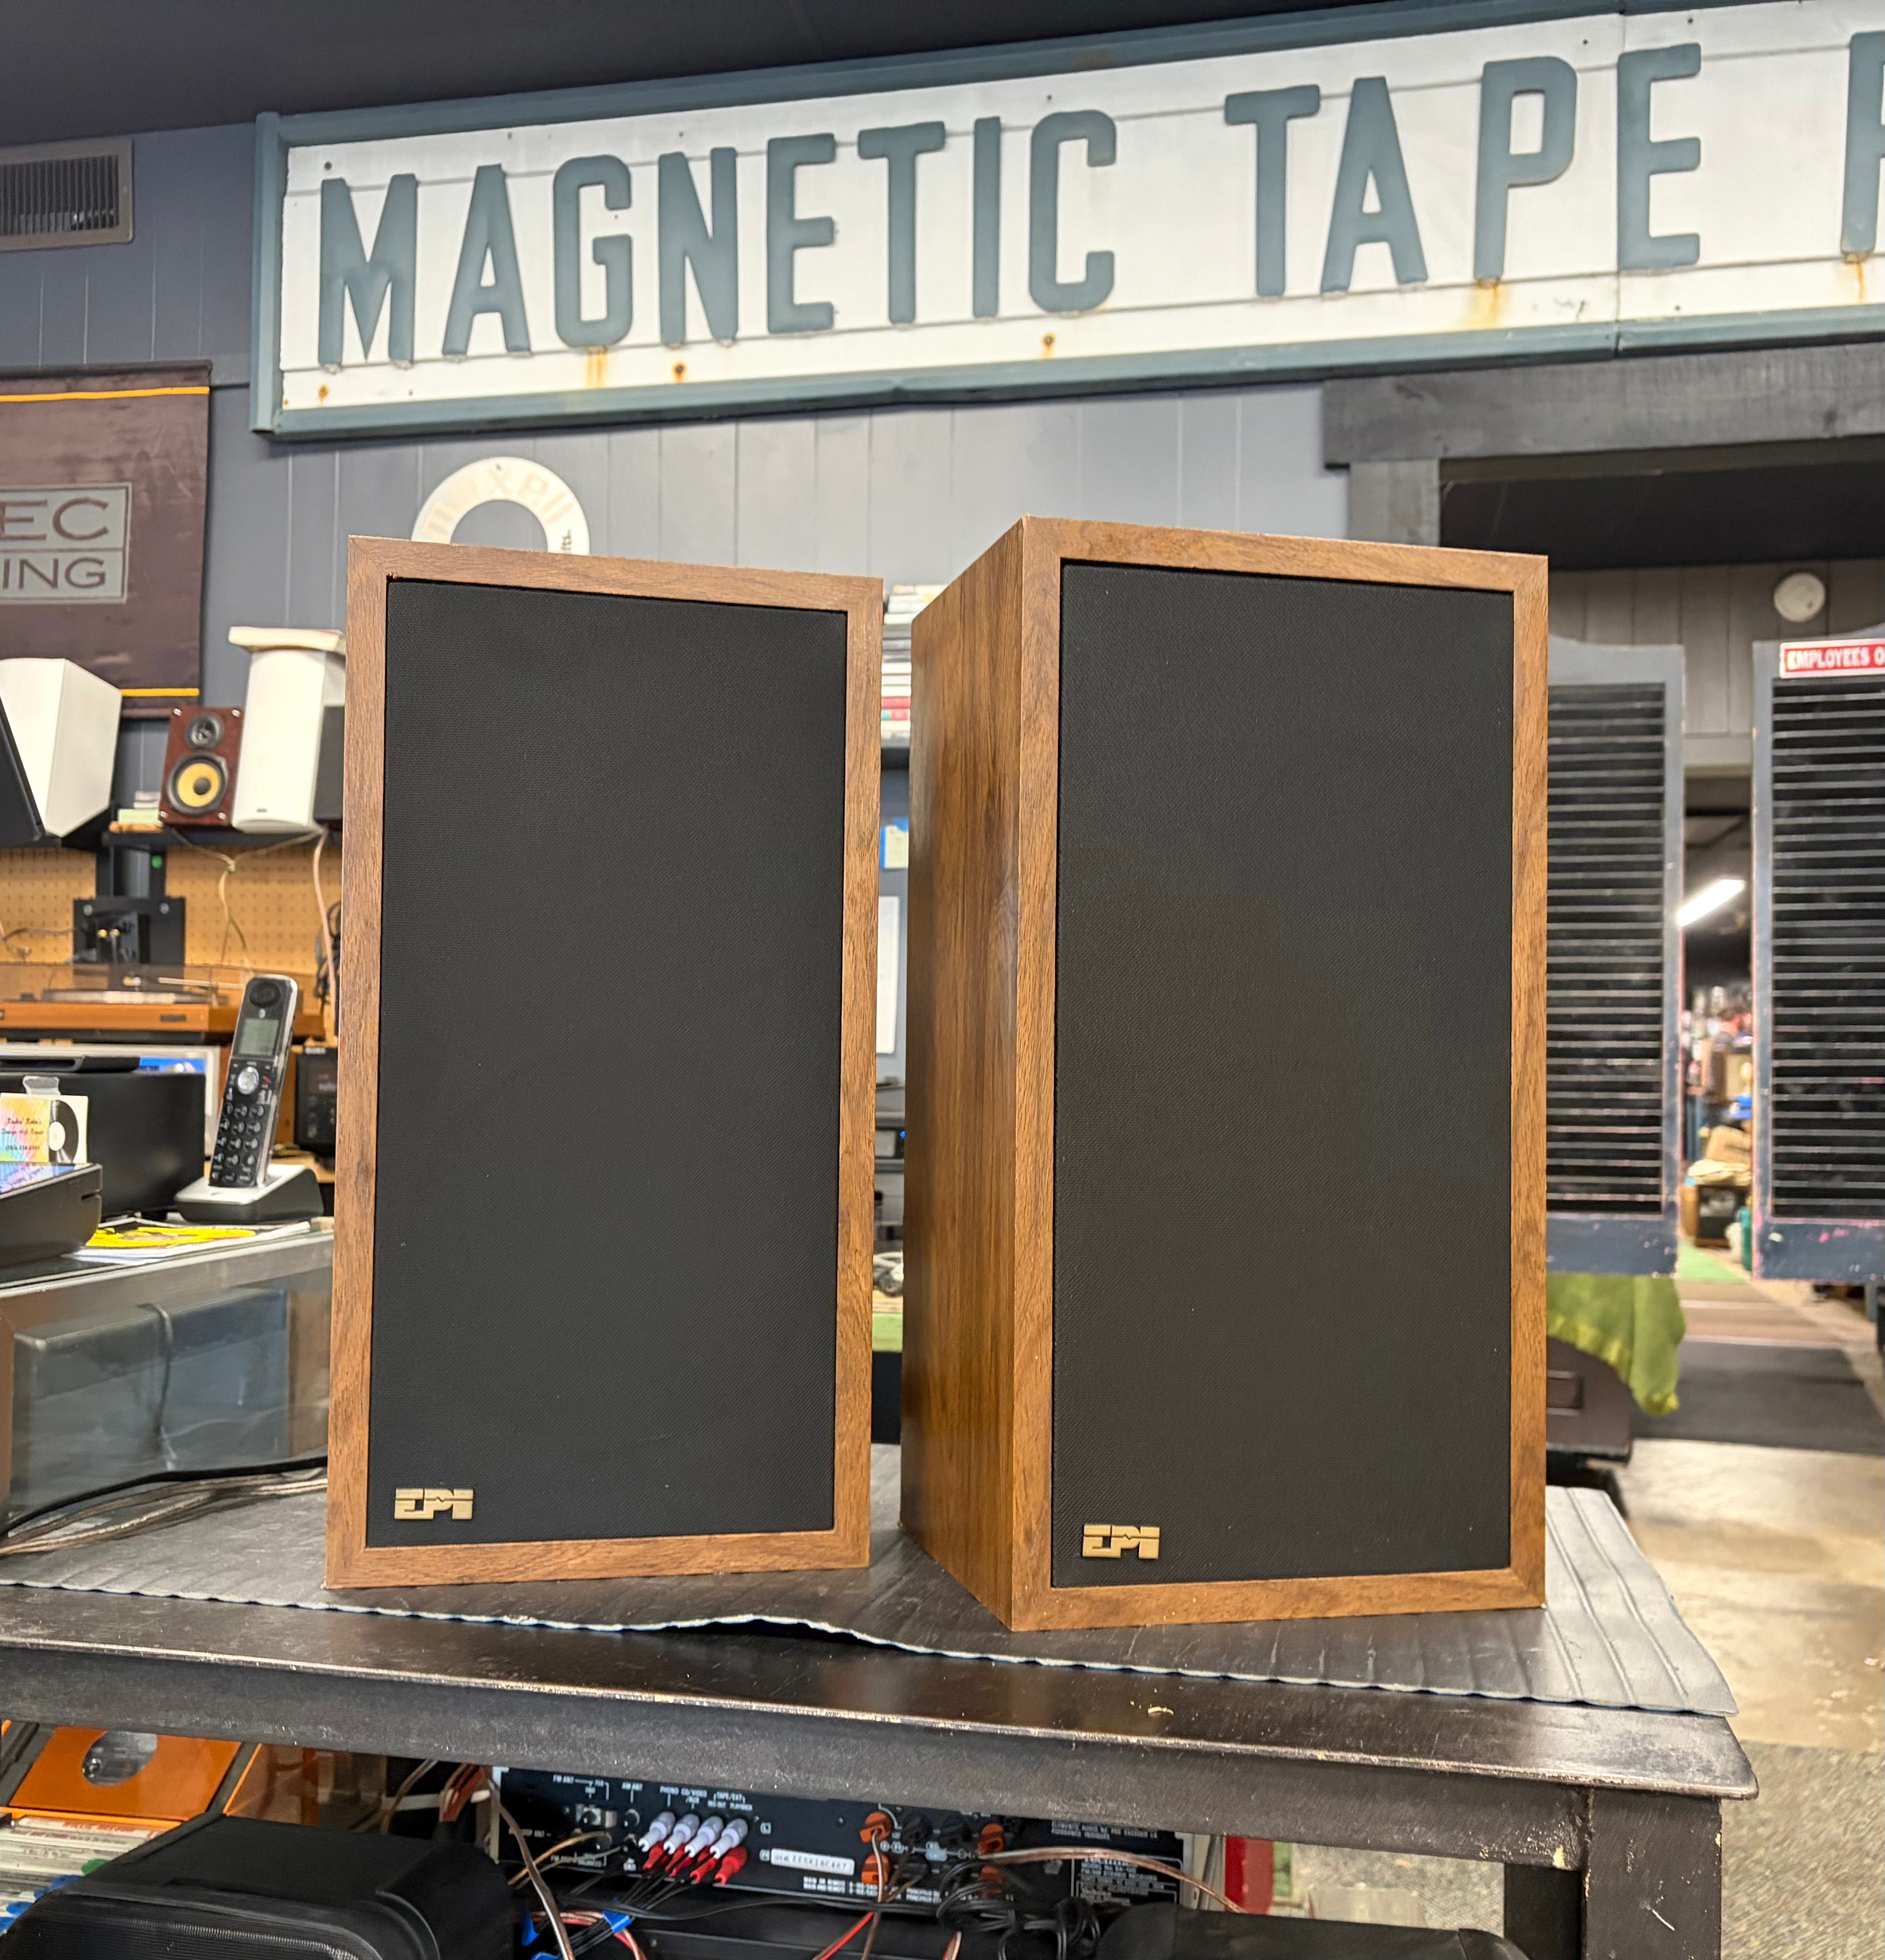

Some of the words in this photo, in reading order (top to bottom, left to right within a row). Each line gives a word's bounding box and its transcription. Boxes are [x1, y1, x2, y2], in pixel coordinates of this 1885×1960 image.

[318, 109, 1117, 366] MAGNETIC
[1224, 42, 1702, 297] TAPE
[1787, 647, 1870, 670] EMPLOYEES
[394, 1488, 474, 1519] EPI
[1082, 1524, 1160, 1559] EPI
